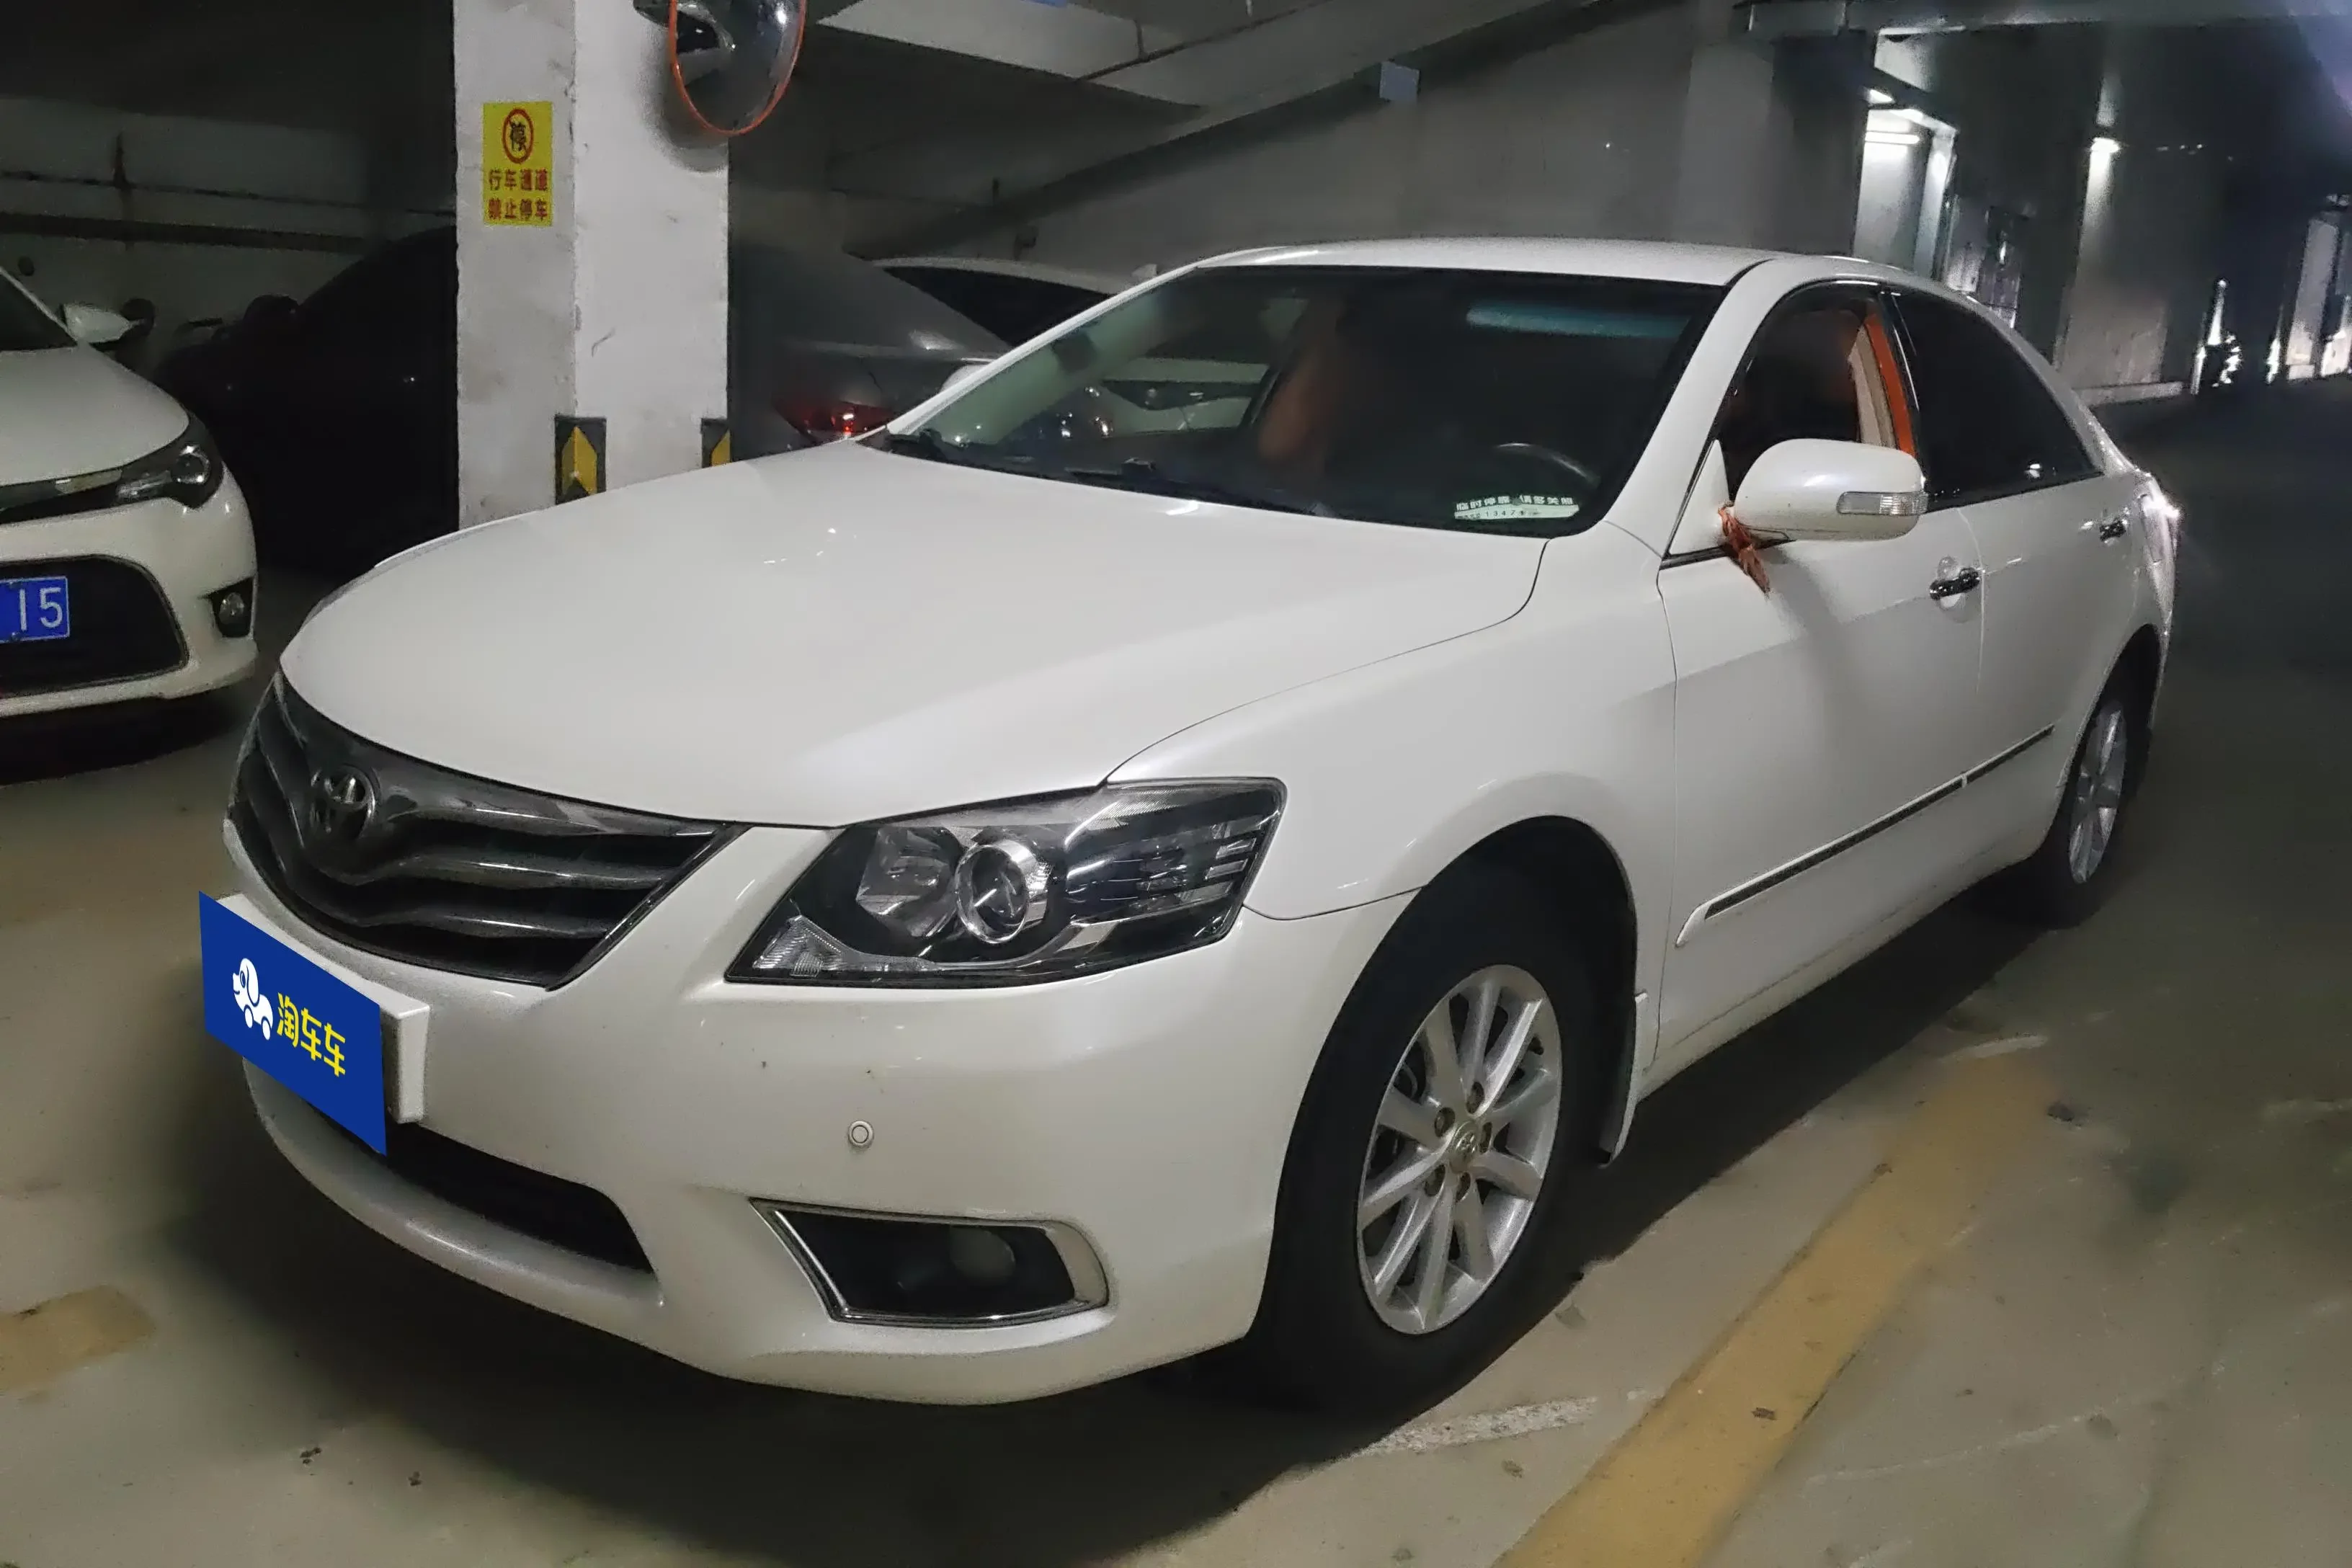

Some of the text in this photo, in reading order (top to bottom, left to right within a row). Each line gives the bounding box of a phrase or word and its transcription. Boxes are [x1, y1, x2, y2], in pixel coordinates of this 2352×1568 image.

[488, 168, 548, 192] 行车通道
[488, 197, 548, 221] 禁止停车
